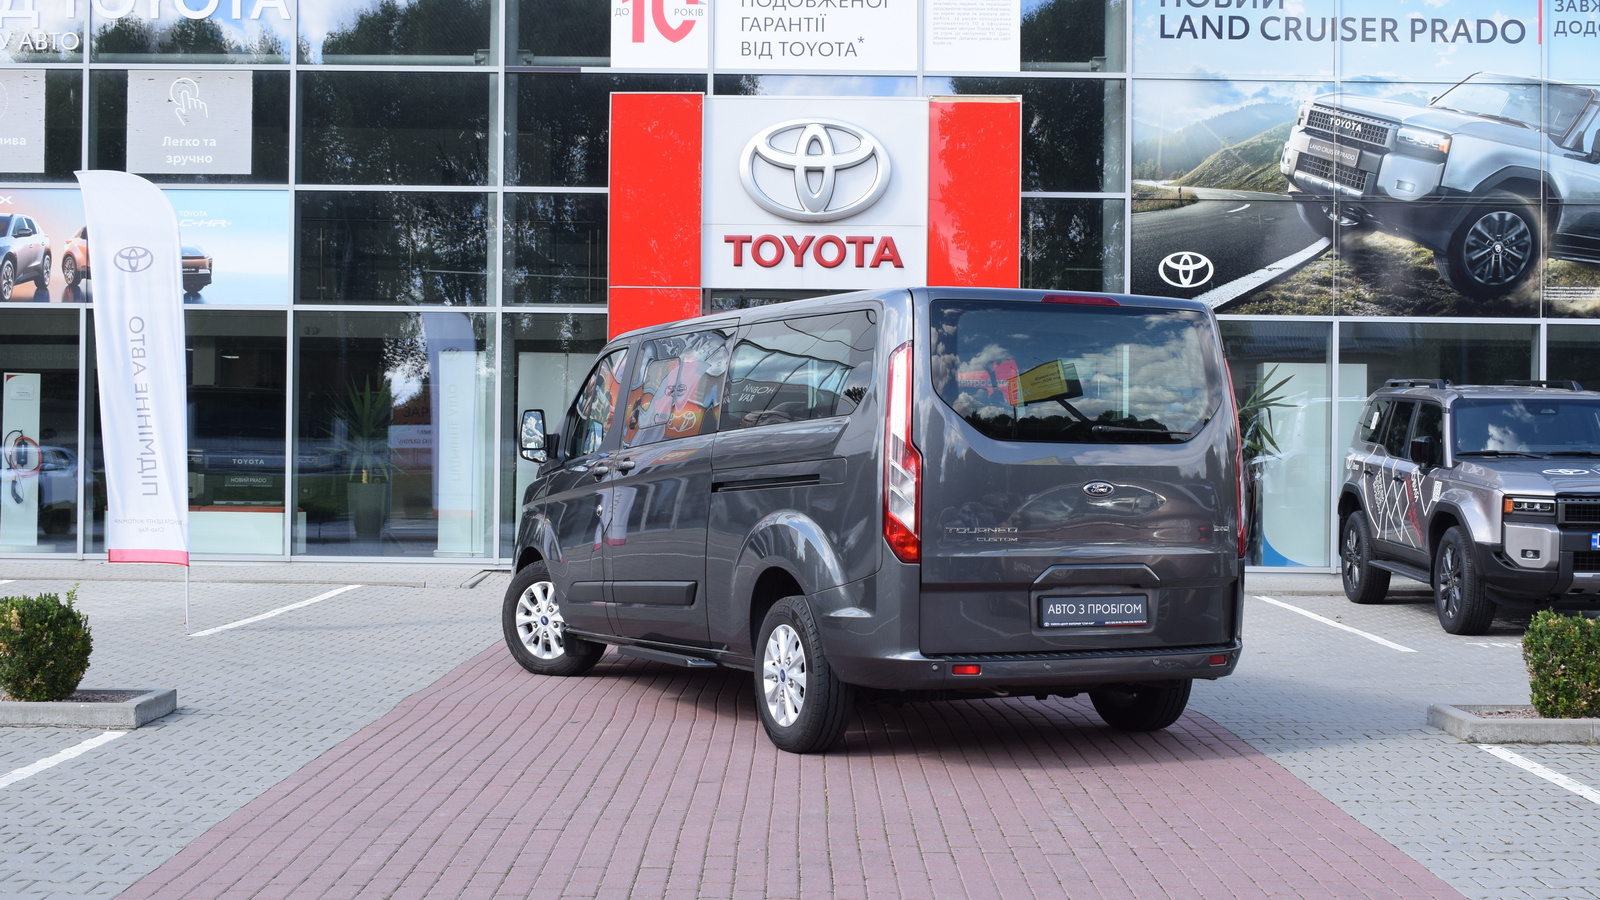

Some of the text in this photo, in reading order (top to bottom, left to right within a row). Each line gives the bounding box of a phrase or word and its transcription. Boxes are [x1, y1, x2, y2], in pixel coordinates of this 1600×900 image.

[615, 8, 630, 17] ДО
[674, 8, 704, 16] РОКІВ
[741, 14, 825, 32] ГАРАНТІЇ
[1160, 15, 1526, 44] LAND CRUISER PRADO
[1554, 20, 1600, 36] ДОД
[19, 32, 80, 50] АВТО
[741, 41, 773, 59] ВІД
[1330, 118, 1361, 132] TOYOTA
[162, 136, 216, 147] Легко та
[166, 155, 213, 166] зручно
[724, 234, 904, 268] TOYOTA
[1048, 604, 1076, 614] АВТО
[1088, 604, 1142, 614] ПРОБІГОМ
